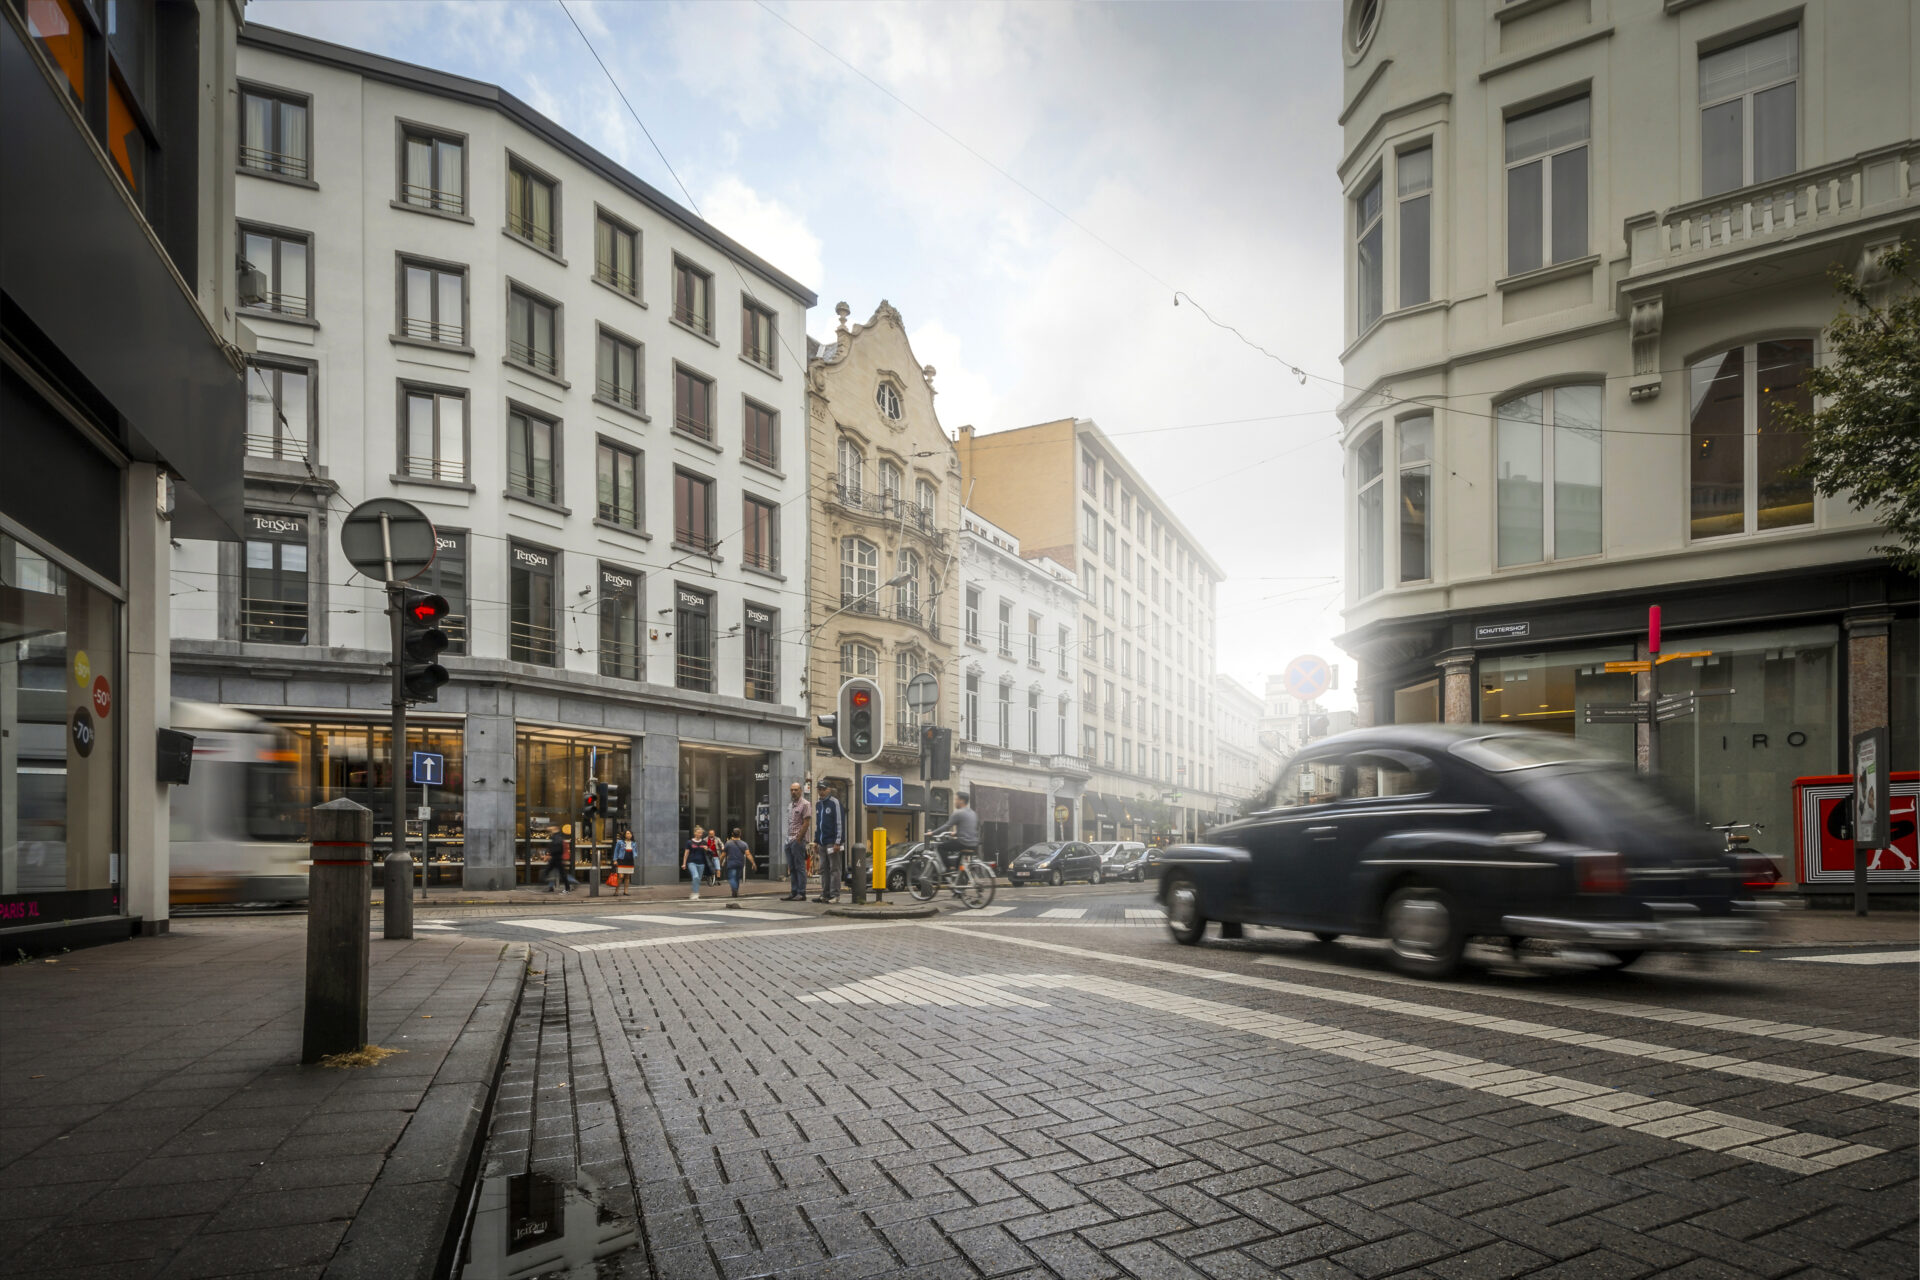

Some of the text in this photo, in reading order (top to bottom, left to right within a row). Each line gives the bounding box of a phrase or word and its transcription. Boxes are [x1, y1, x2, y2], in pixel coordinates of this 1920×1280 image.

[253, 517, 299, 532] TenSen
[436, 538, 457, 549] Sen
[514, 549, 548, 565] TenSen
[603, 572, 632, 587] TenSen
[679, 592, 704, 605] TenSen
[747, 609, 769, 622] TenSen
[73, 721, 94, 743] -70%
[28, 901, 40, 917] XL
